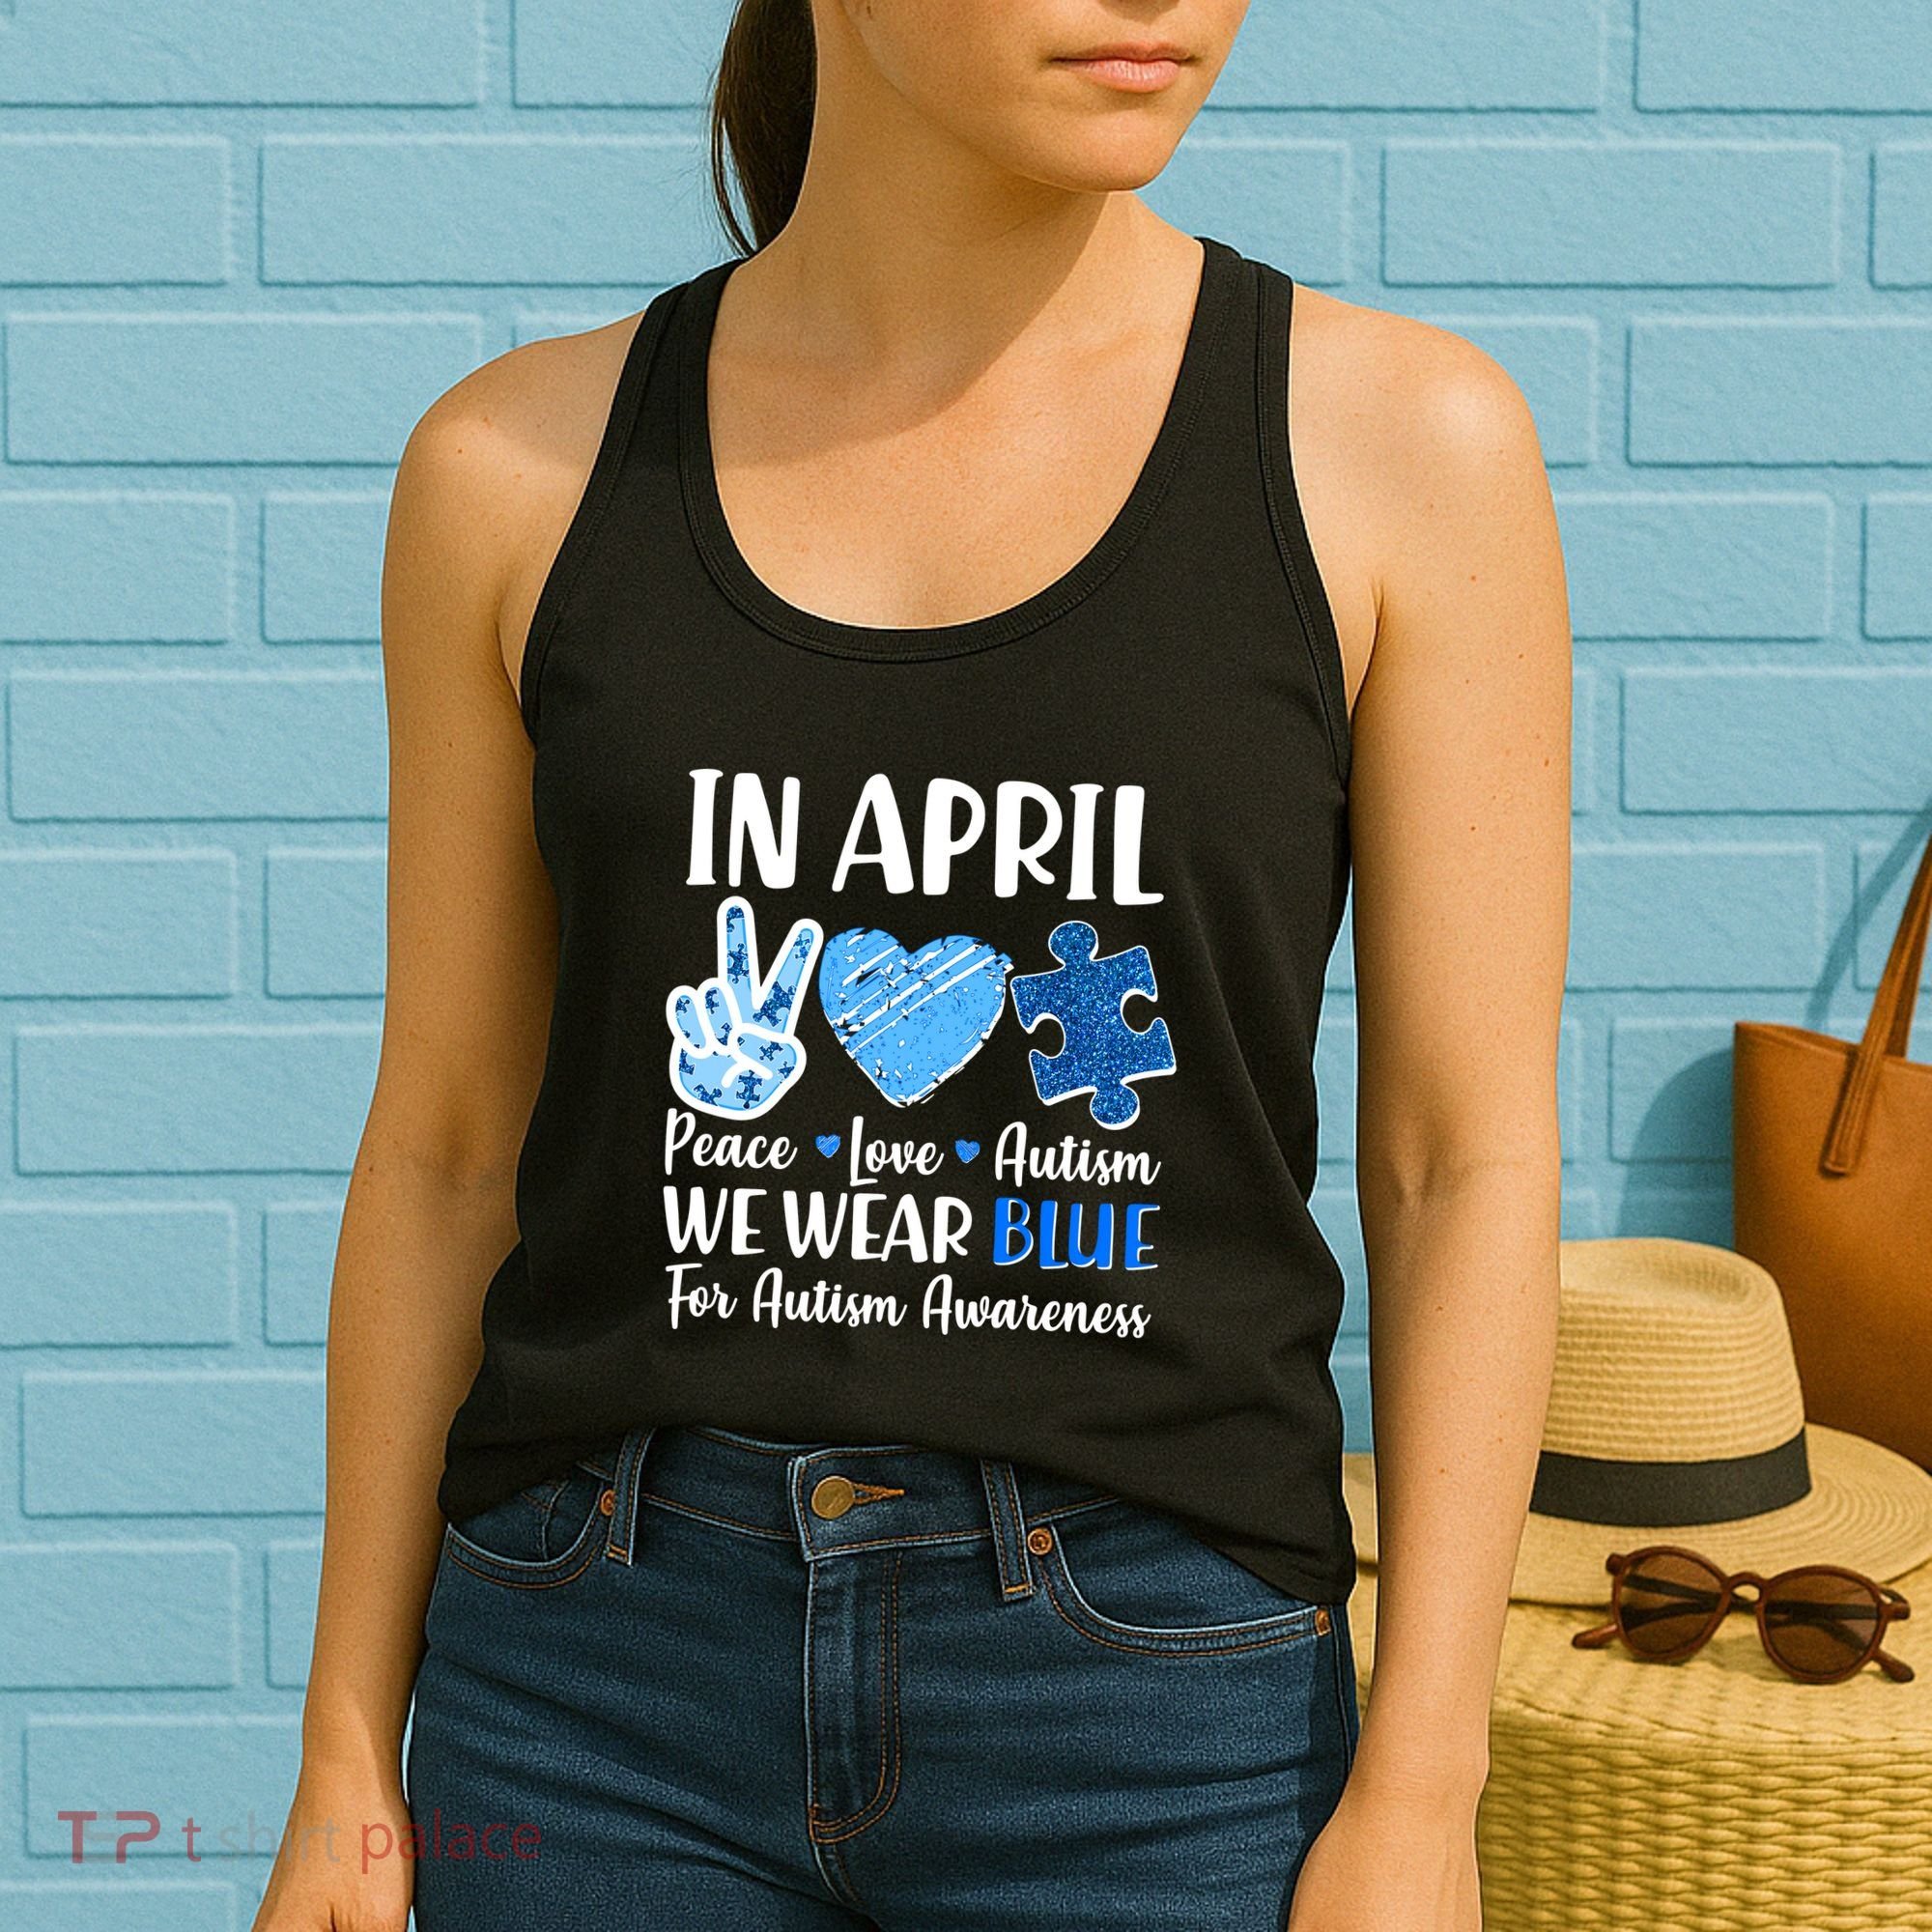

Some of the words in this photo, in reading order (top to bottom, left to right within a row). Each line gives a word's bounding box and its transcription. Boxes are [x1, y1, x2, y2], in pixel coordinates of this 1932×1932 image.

[685, 769, 801, 889] IN
[832, 774, 1164, 905] APRIL
[665, 1108, 798, 1175] Peace
[850, 1116, 945, 1186] Love
[995, 1122, 1162, 1187] Autism
[664, 1186, 768, 1255] WE
[783, 1191, 973, 1264] WEAR
[993, 1198, 1161, 1270] BLUE
[666, 1264, 738, 1329] For
[753, 1266, 907, 1328] Autism
[923, 1274, 1151, 1338] Awareness
